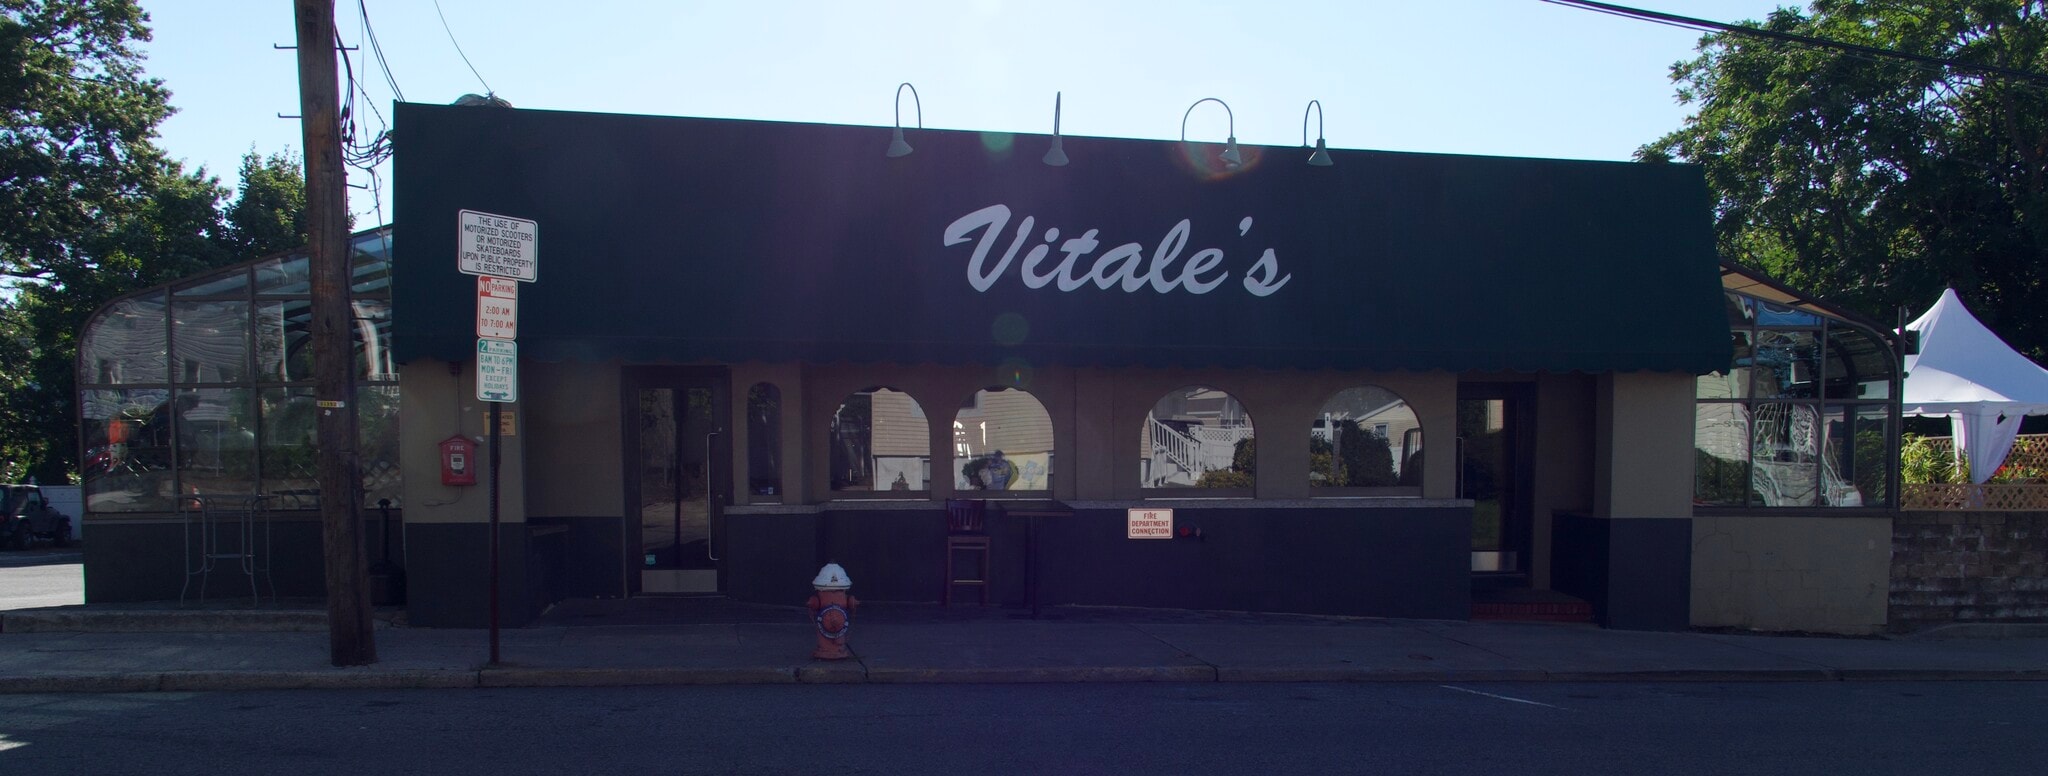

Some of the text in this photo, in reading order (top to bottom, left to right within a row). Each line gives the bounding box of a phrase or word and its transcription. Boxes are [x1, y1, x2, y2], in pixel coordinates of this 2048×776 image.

[479, 216, 520, 230] THE USE OF
[464, 224, 533, 242] MOTORIZED SCOOTERS
[476, 234, 522, 248] OR MOTORIZED
[476, 244, 521, 258] SKATEBOARDS
[944, 204, 1291, 297] Vitale's
[463, 252, 534, 268] UPON PUBLIC PROPERTY
[476, 262, 520, 276] IS RESTRICTED
[480, 280, 514, 294] NO PARKING
[486, 306, 510, 316] 2:00 AM
[481, 318, 514, 329] TO 7:00 AM
[480, 340, 486, 351] 2
[494, 356, 501, 364] TO
